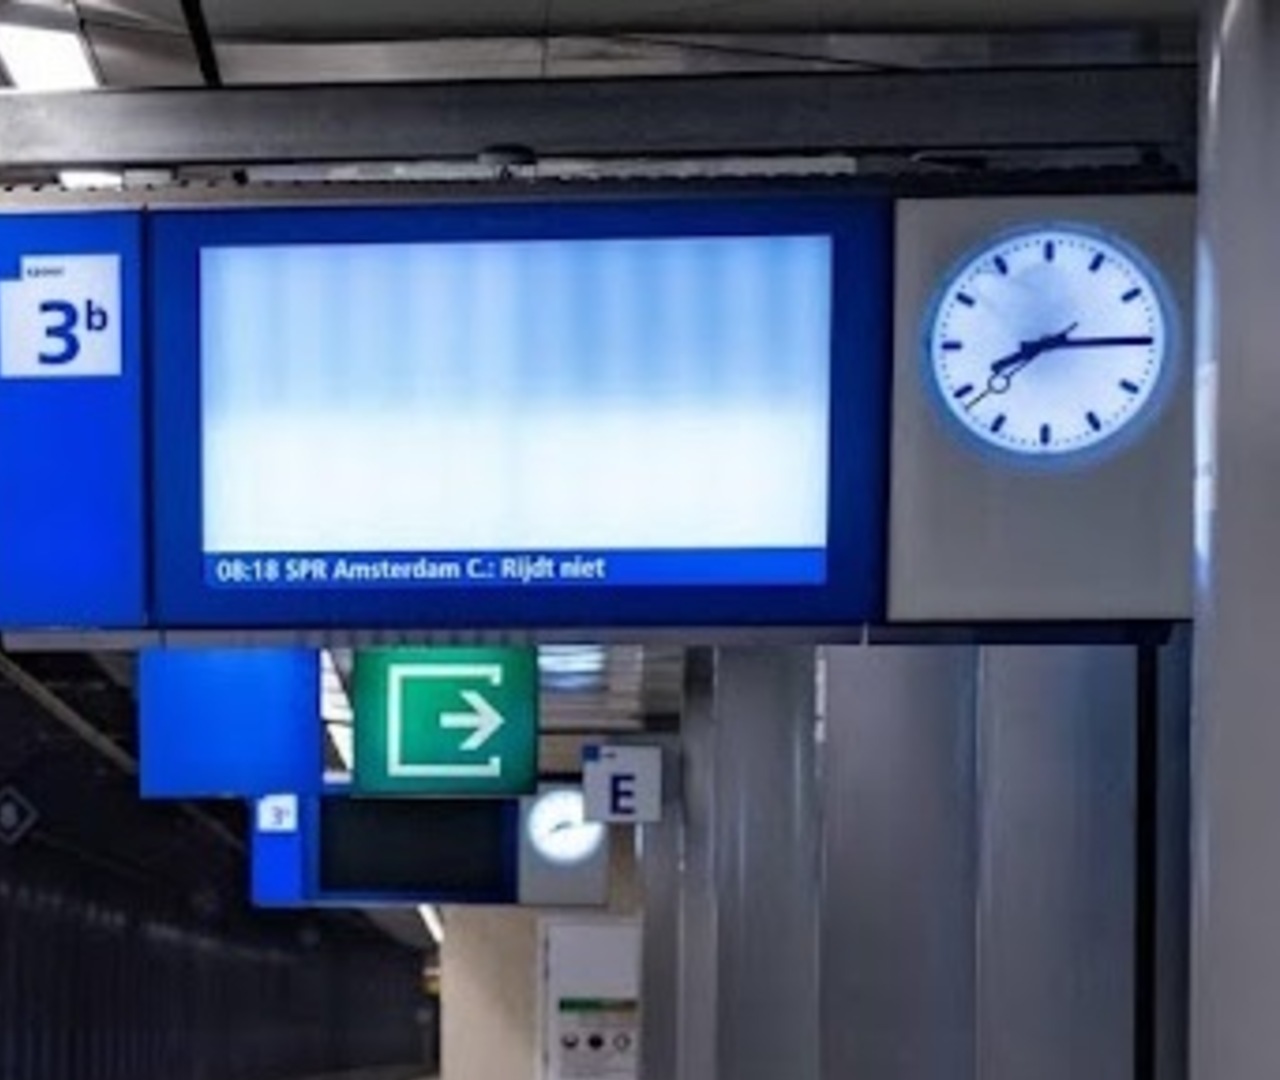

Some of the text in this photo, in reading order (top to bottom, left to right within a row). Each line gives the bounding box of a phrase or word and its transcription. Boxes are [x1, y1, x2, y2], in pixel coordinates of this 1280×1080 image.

[216, 557, 280, 583] 08:18
[285, 556, 328, 582] SPR
[333, 555, 460, 580] Amsterdam
[501, 554, 555, 586] Rijdt
[559, 554, 606, 579] niet
[609, 773, 636, 815] E
